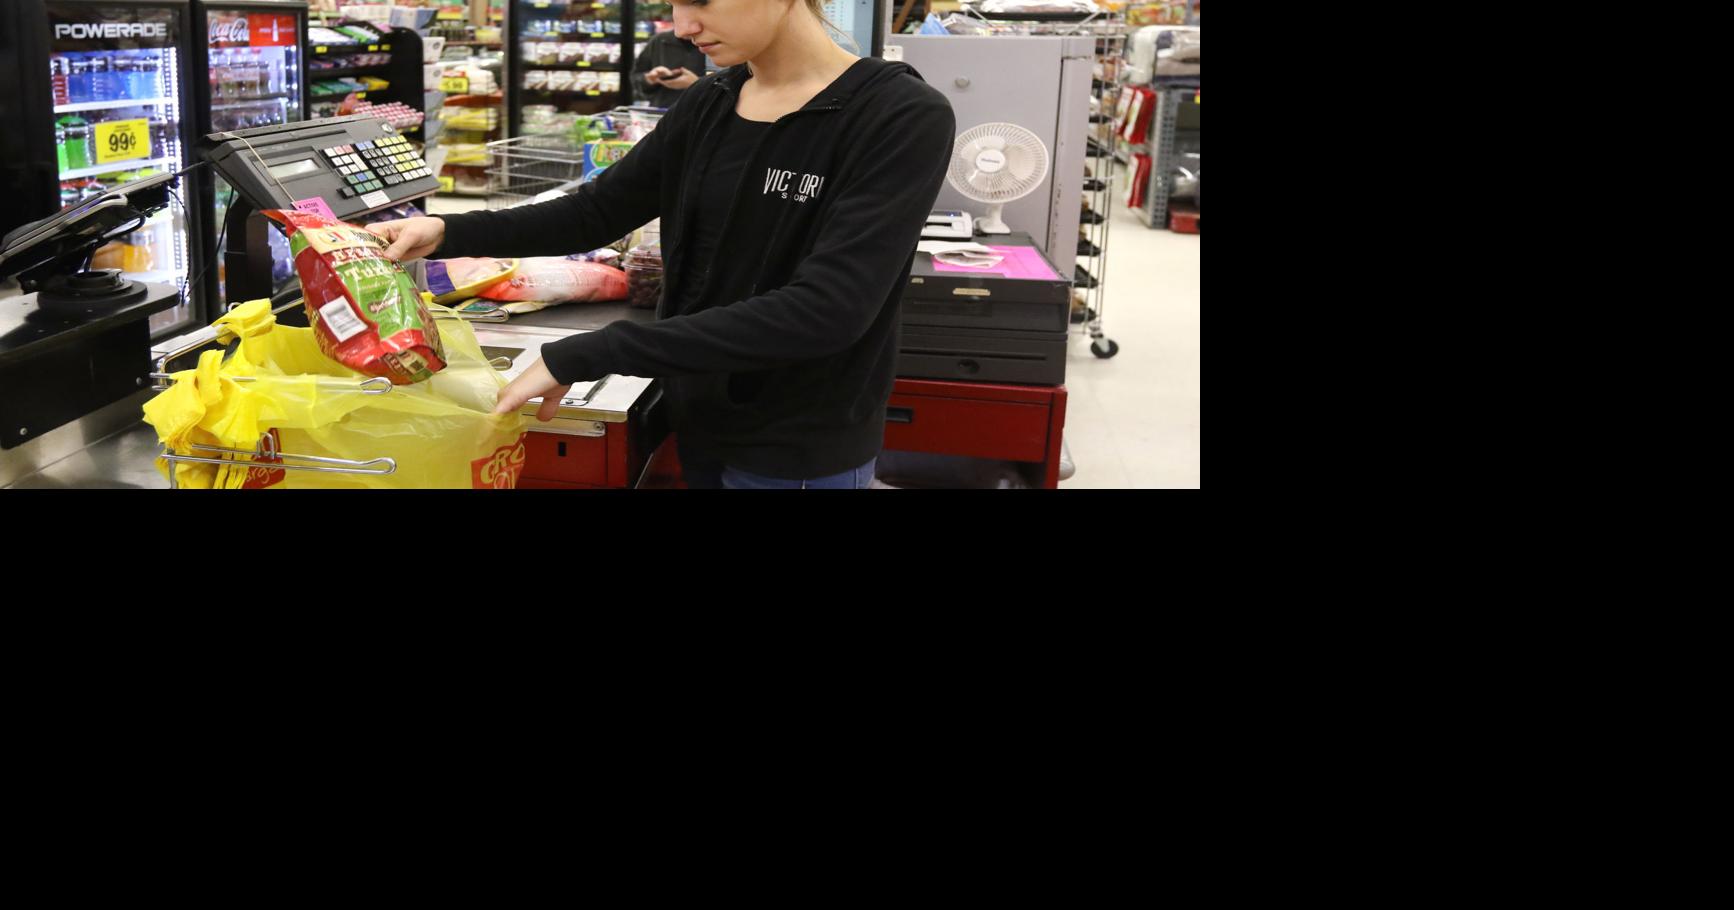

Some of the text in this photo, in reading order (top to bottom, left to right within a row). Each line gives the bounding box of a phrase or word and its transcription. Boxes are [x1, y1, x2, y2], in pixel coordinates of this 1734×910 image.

[55, 23, 167, 39] POWERADE
[763, 167, 825, 198] VICORI
[781, 191, 808, 203] SORT
